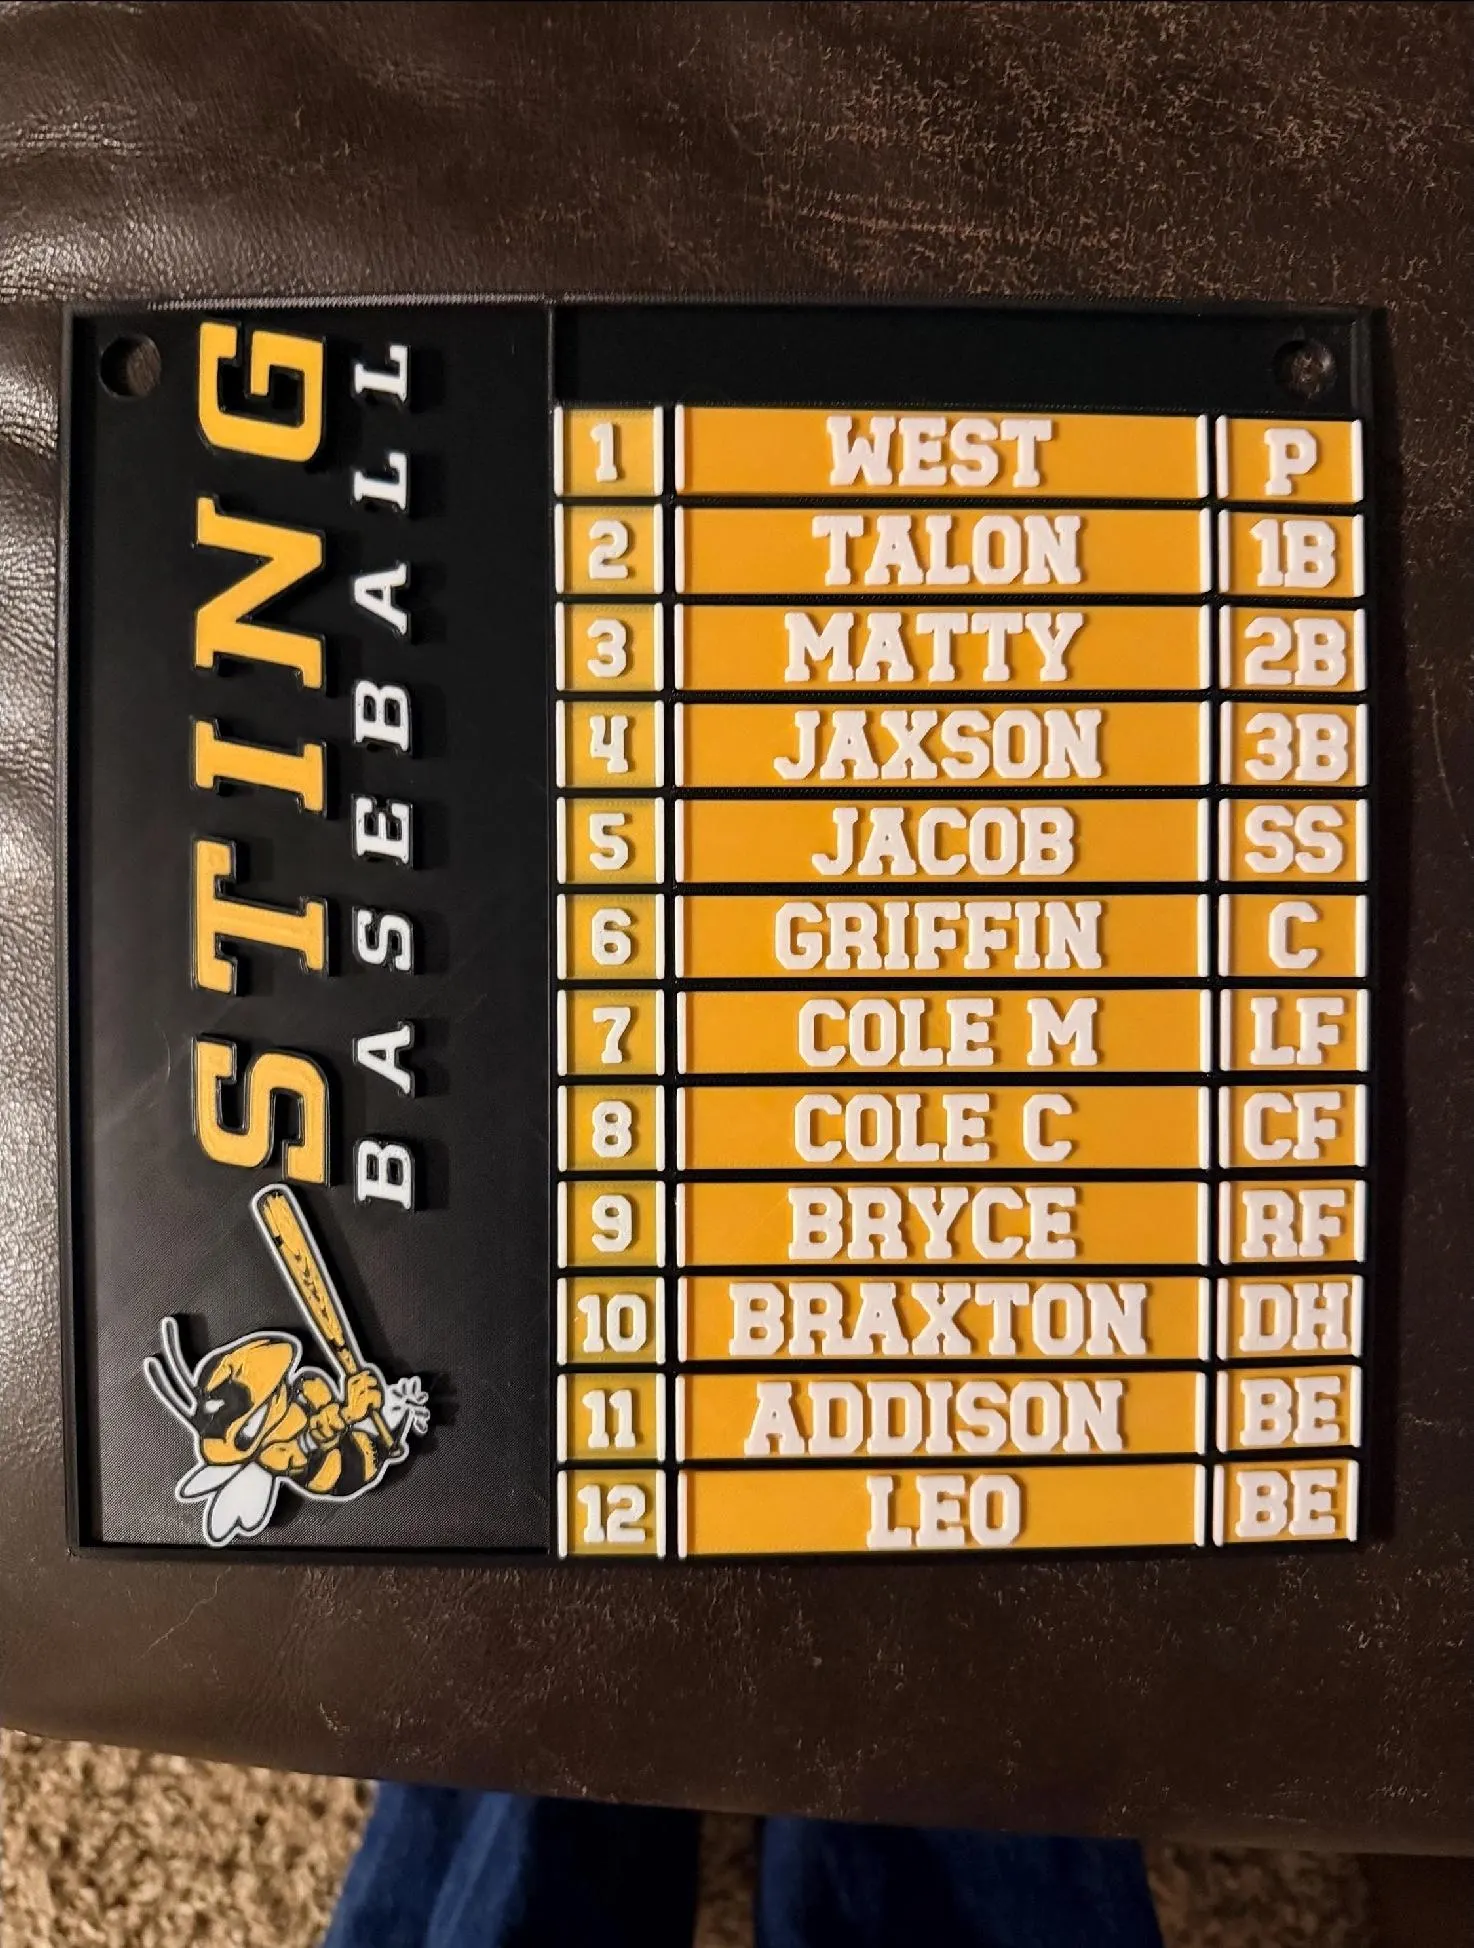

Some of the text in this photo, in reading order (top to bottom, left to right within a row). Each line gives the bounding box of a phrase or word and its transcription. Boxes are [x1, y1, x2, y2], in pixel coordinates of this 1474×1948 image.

[590, 416, 1316, 495] 1 WEST P
[589, 515, 1335, 587] 2 TALON 1B
[587, 612, 1345, 685] 3 MATTY 2B
[195, 321, 328, 1184] STING
[354, 343, 412, 1210] BASEBALL
[590, 710, 1347, 781] 4 JAXSON 3B
[590, 806, 1342, 875] 5 JACOB SS
[592, 902, 1317, 969] 6 GRIFFIN C
[593, 998, 1343, 1066] 7 COLE M LF
[592, 1092, 1340, 1161] 8 COLE C CF
[592, 1188, 1344, 1259] 9 BRYCE RF
[578, 1283, 1348, 1356] 10 BRAXTON DH
[583, 1377, 1340, 1456] 11 ADDISON BE
[577, 1470, 1336, 1550] 12 LEO BE
